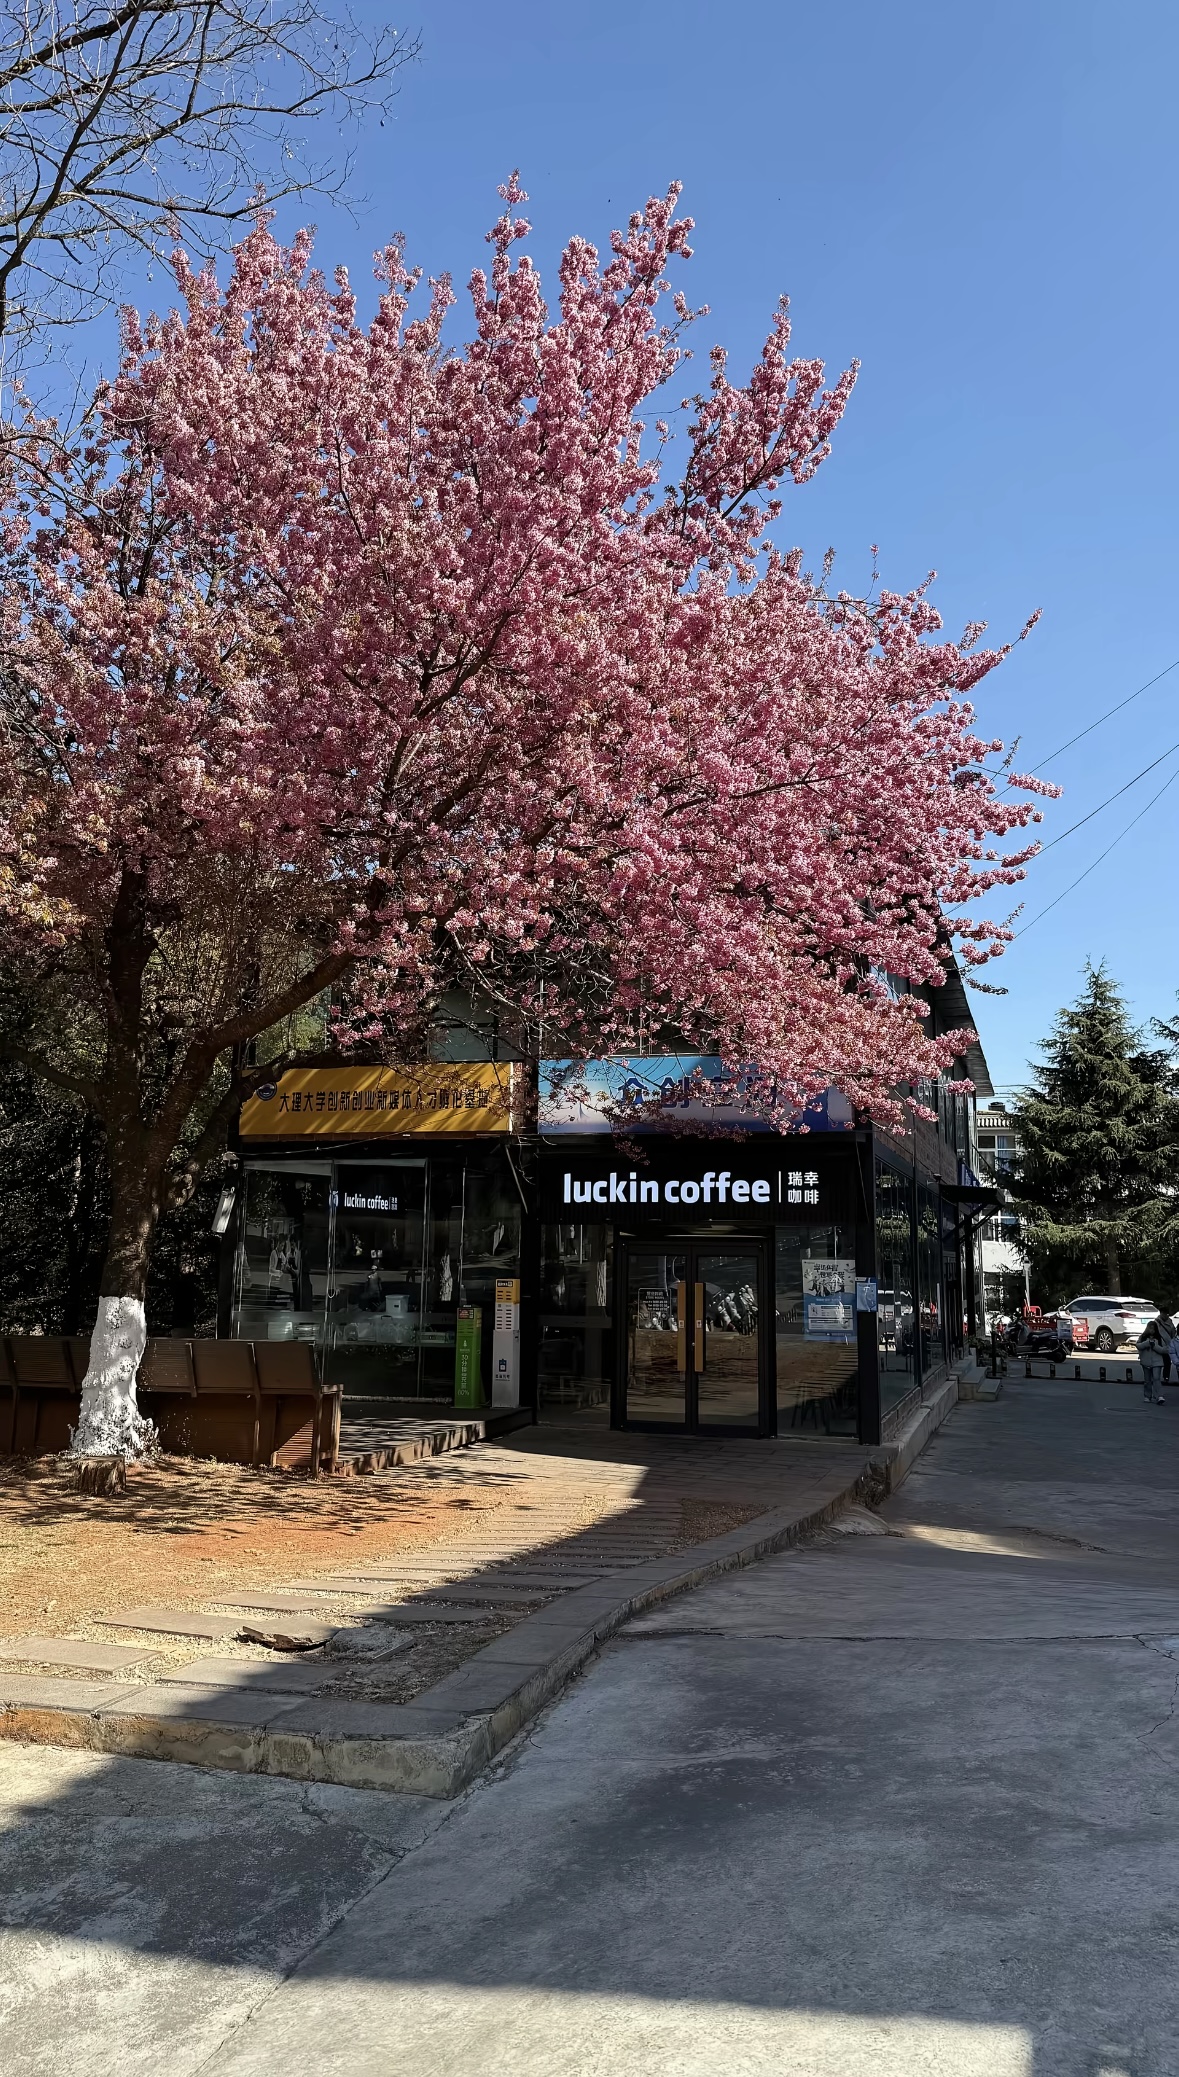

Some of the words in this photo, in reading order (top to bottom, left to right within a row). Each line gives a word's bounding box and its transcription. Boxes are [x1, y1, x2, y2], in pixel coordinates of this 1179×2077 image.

[787, 1170, 819, 1187] 瑞幸
[563, 1172, 660, 1203] luckin
[664, 1171, 770, 1204] coffee
[344, 1192, 366, 1208] luckin
[367, 1194, 389, 1210] coffee
[787, 1188, 819, 1205] 咖啡
